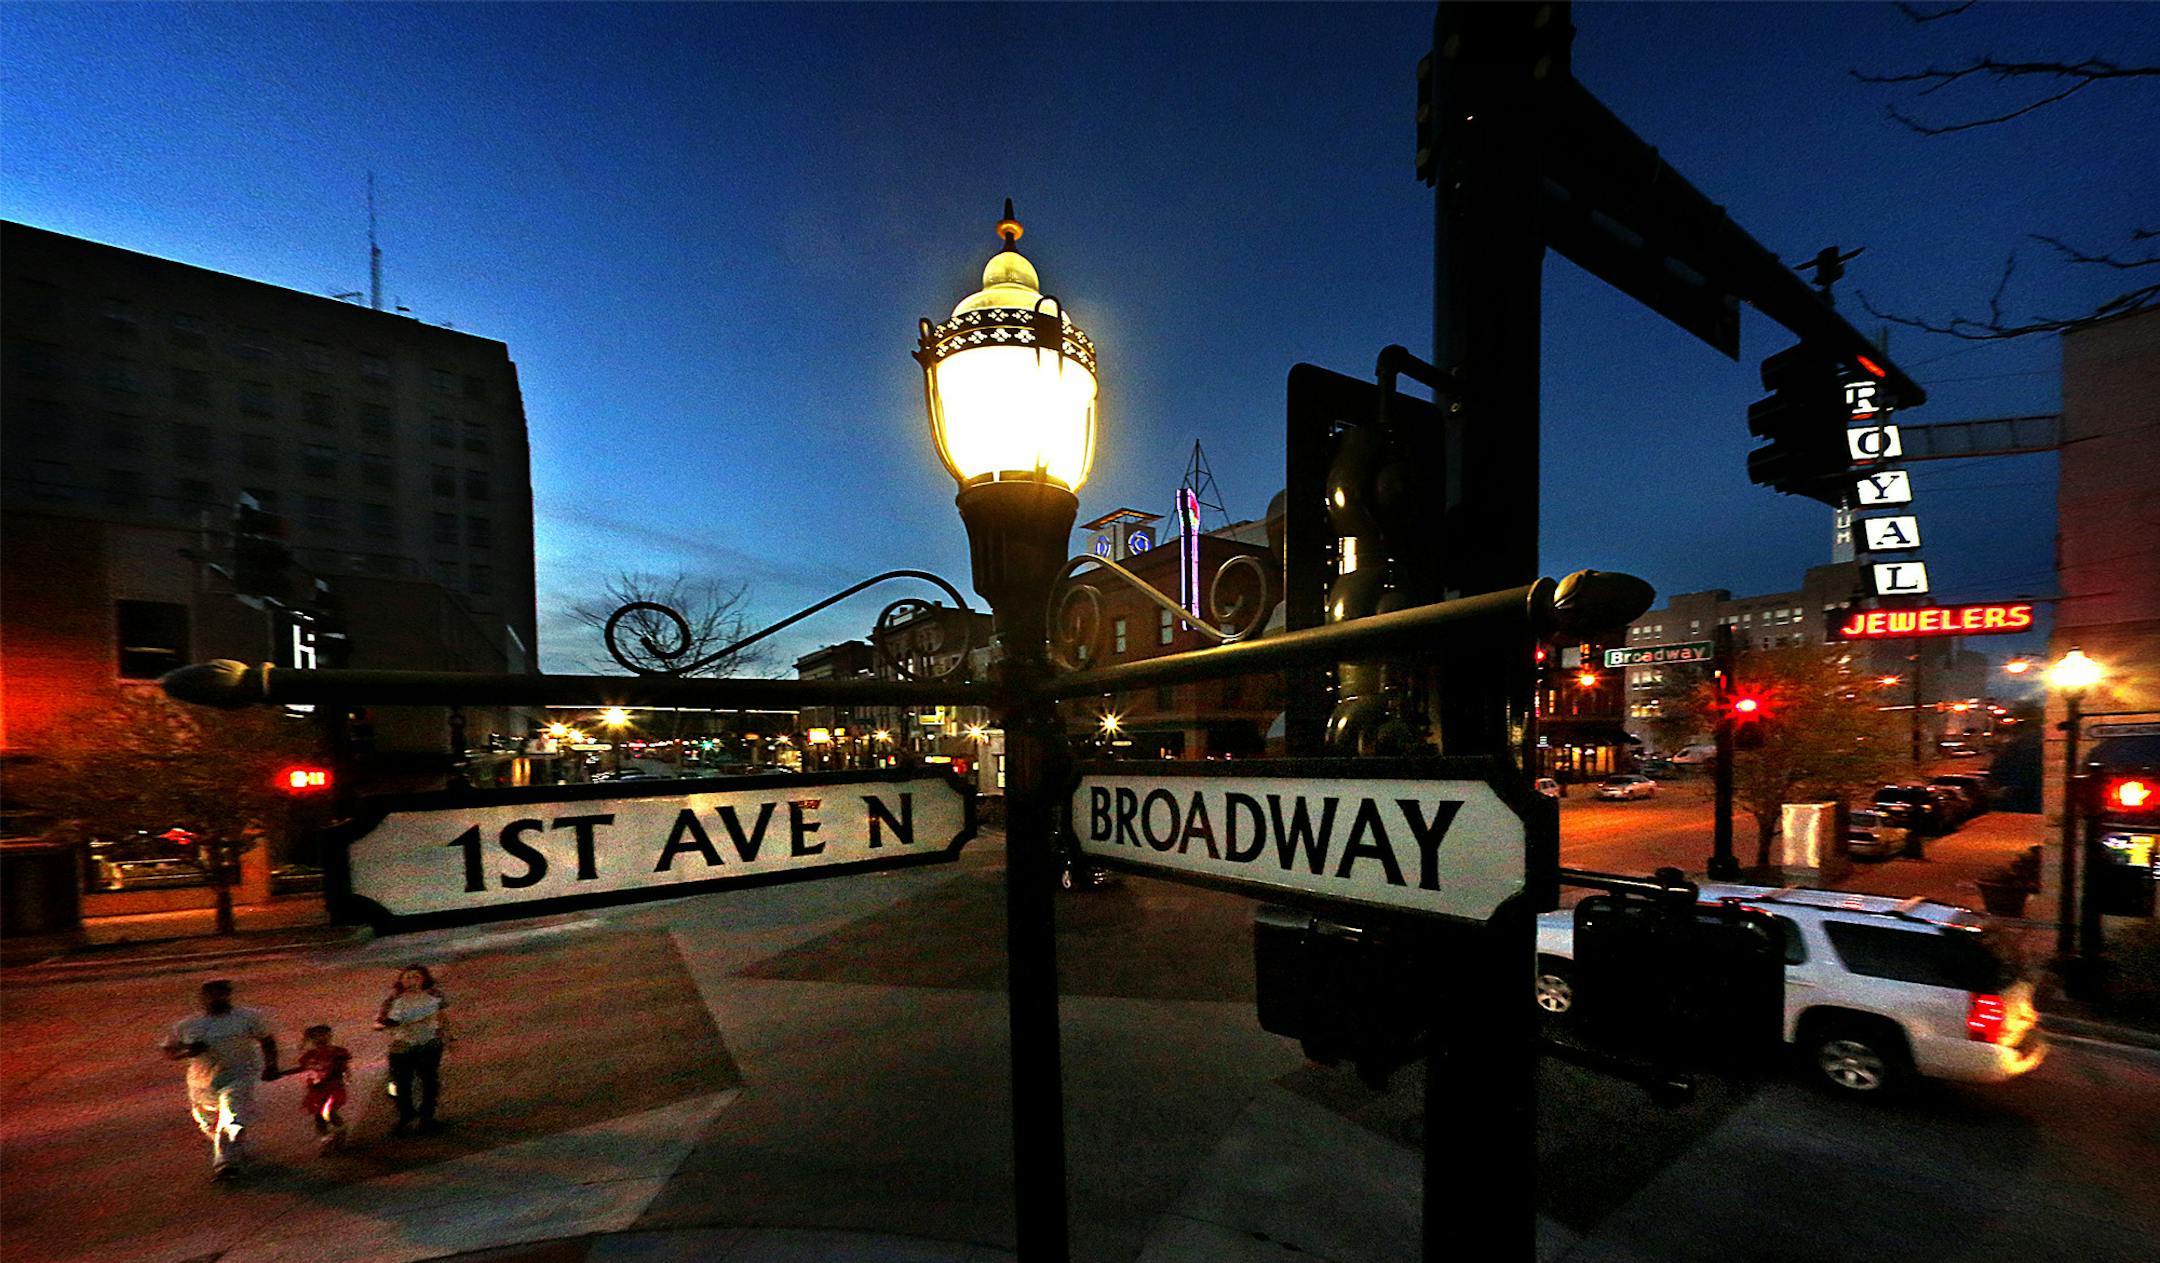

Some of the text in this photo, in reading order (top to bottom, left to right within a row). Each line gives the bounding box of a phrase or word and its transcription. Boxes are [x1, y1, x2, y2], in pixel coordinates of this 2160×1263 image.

[1850, 384, 1918, 591] ROYAL
[1610, 646, 1706, 665] Broadway
[1841, 605, 2032, 634] JEWELERS
[447, 793, 914, 893] 1ST AVE N
[1090, 786, 1465, 891] BROADWAY
